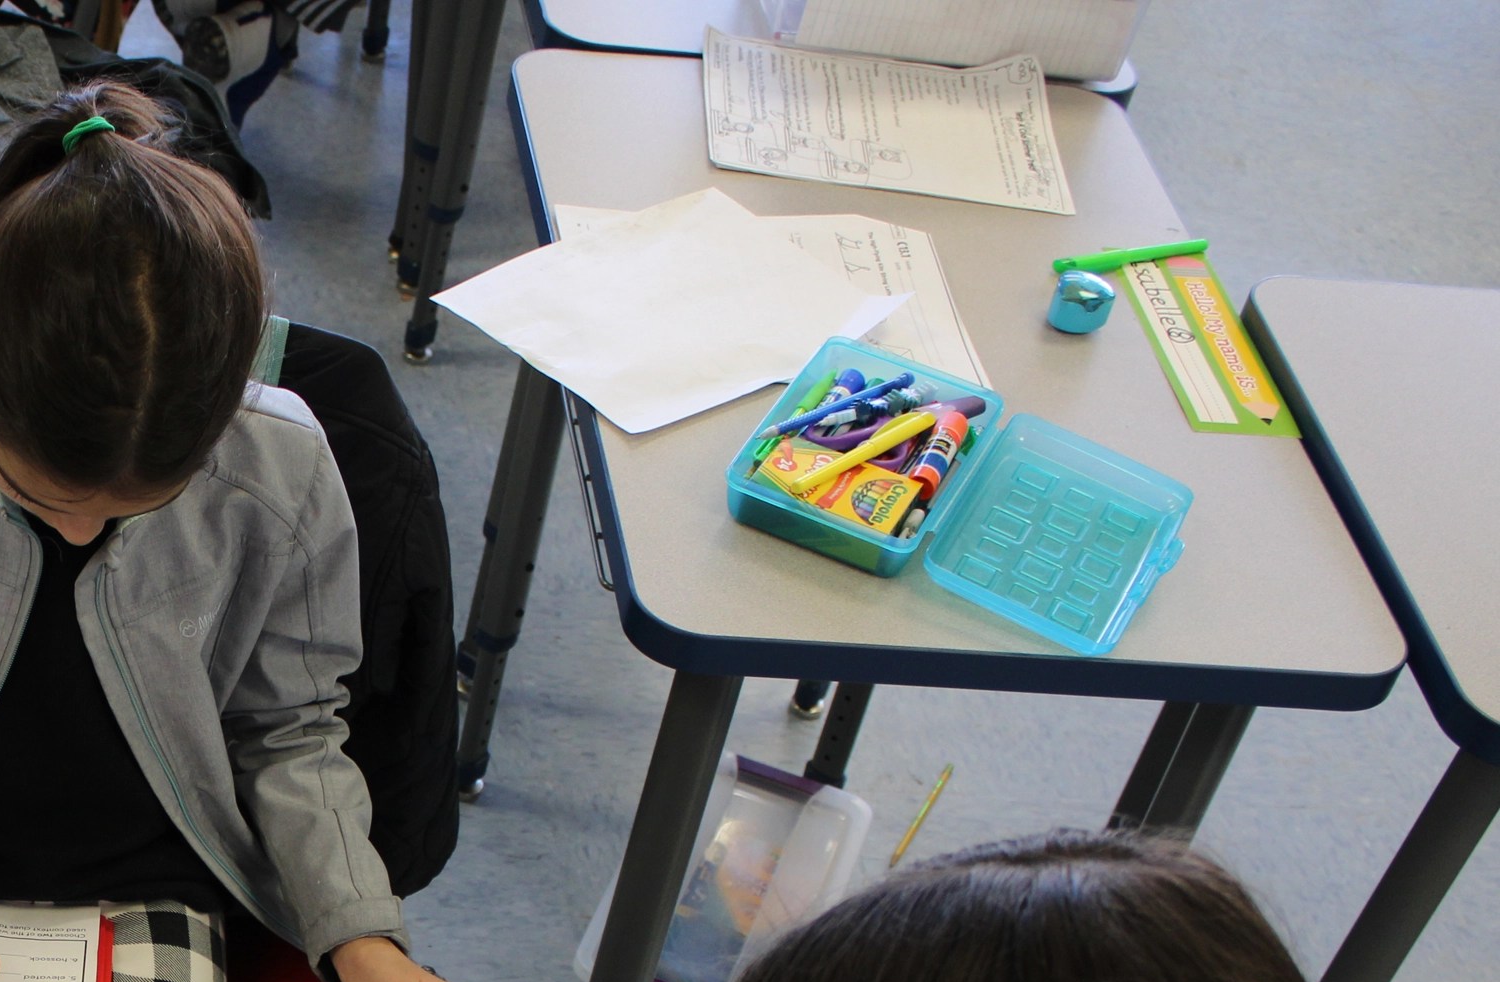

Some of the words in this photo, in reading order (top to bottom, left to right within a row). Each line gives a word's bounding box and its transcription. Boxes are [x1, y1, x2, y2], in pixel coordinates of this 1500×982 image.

[1188, 282, 1216, 317] Hello!
[1204, 315, 1224, 336] My
[1217, 338, 1244, 373] name
[871, 482, 909, 527] Crayola
